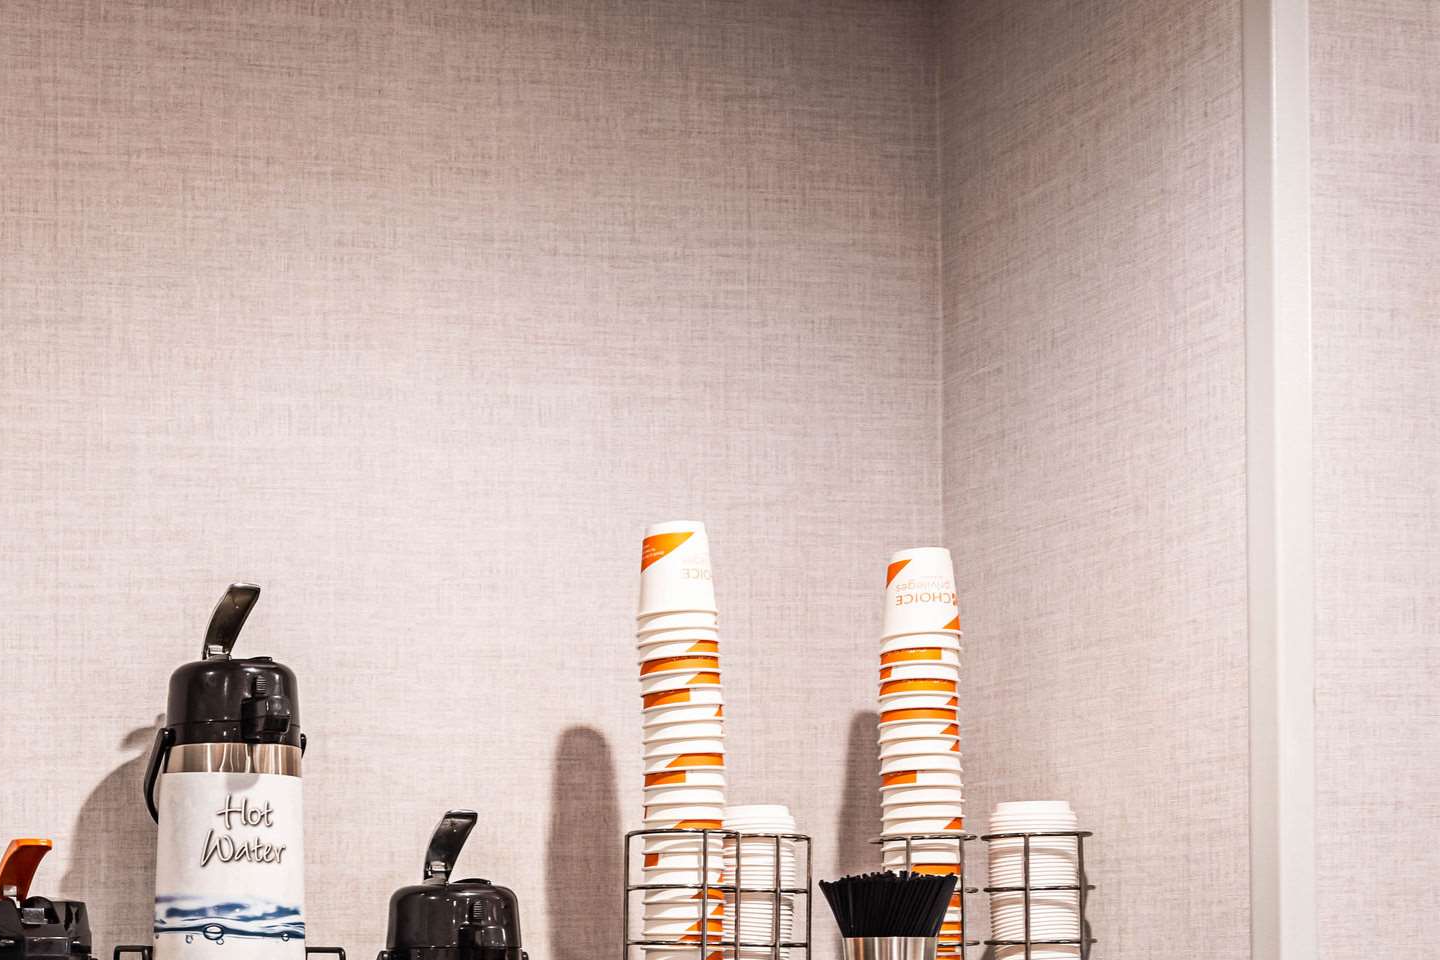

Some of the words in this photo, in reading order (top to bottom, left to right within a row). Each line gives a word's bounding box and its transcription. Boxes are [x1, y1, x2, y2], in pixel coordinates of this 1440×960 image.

[895, 592, 952, 606] CHOICE
[216, 793, 274, 831] Hot
[201, 829, 287, 868] Water
